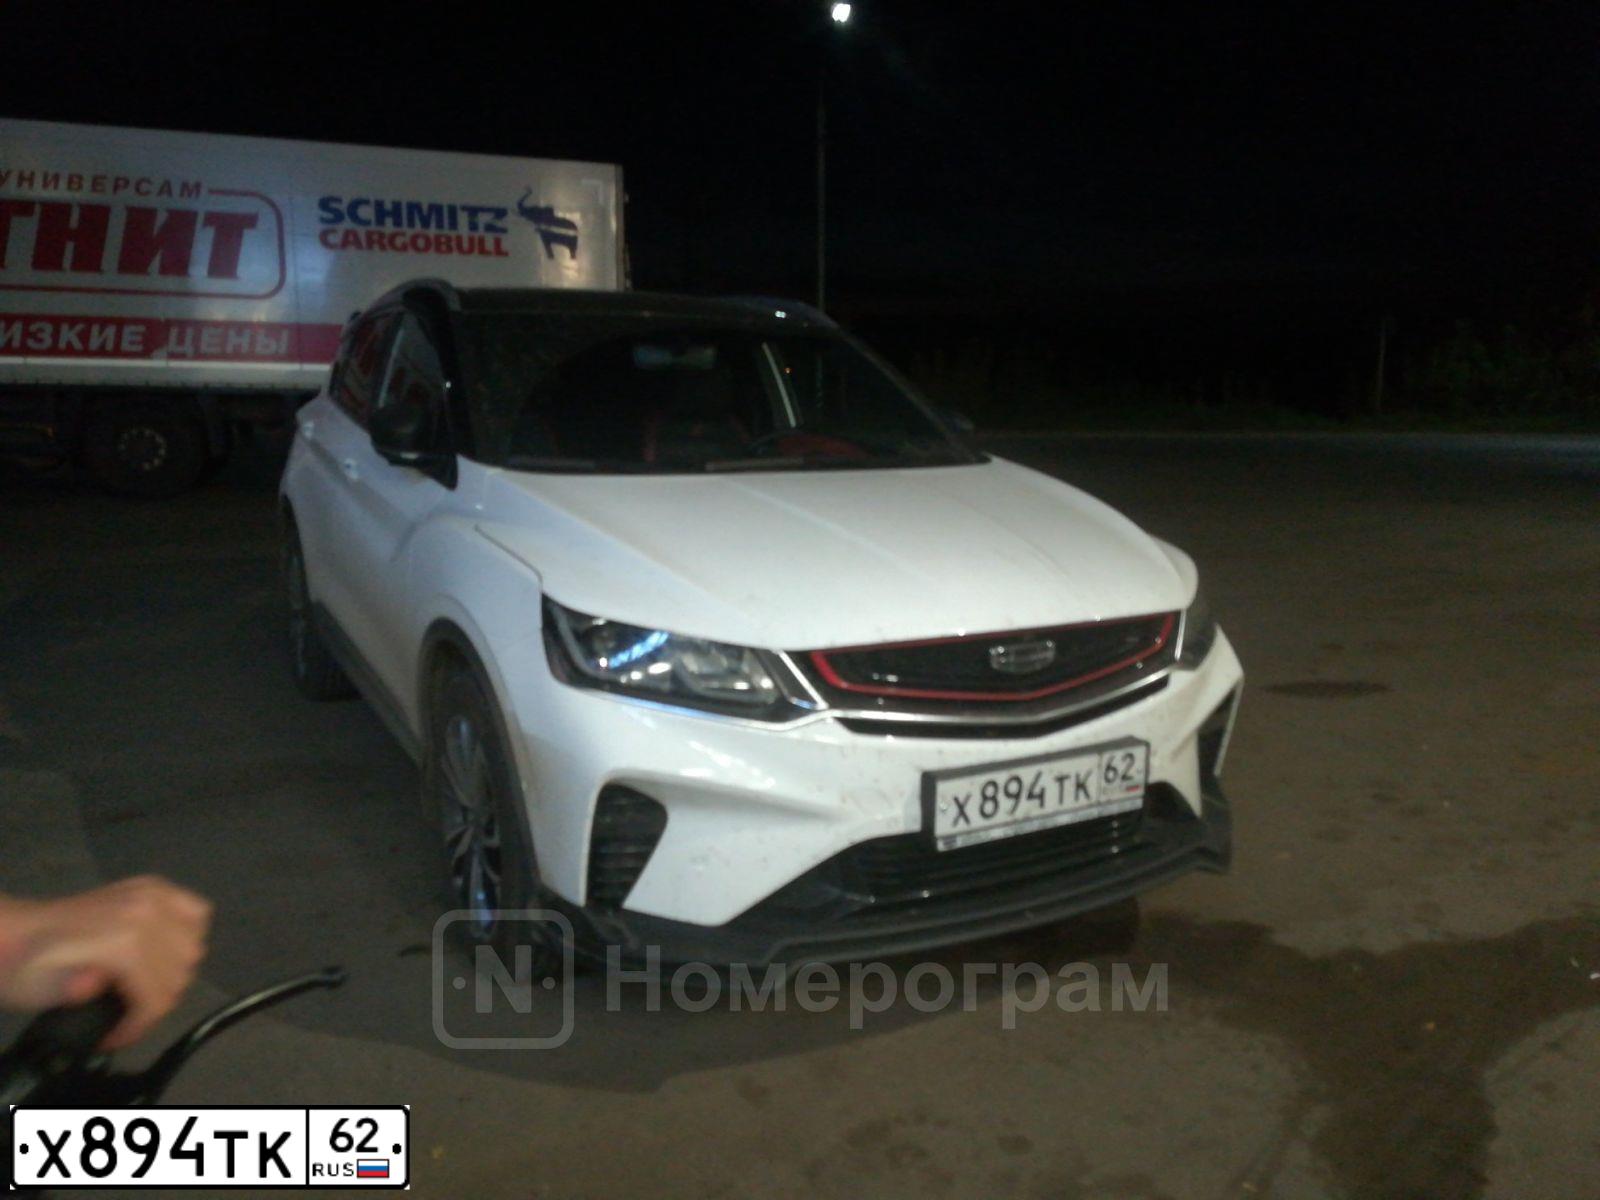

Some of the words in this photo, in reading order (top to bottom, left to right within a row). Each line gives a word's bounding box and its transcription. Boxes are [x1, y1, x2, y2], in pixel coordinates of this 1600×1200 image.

[0, 170, 202, 198] УНИВЕРСАМ
[318, 196, 508, 234] SCHMITZ
[319, 228, 508, 257] CARGOBULL
[167, 325, 289, 358] ЦЕНЫ
[1103, 752, 1136, 785] 62
